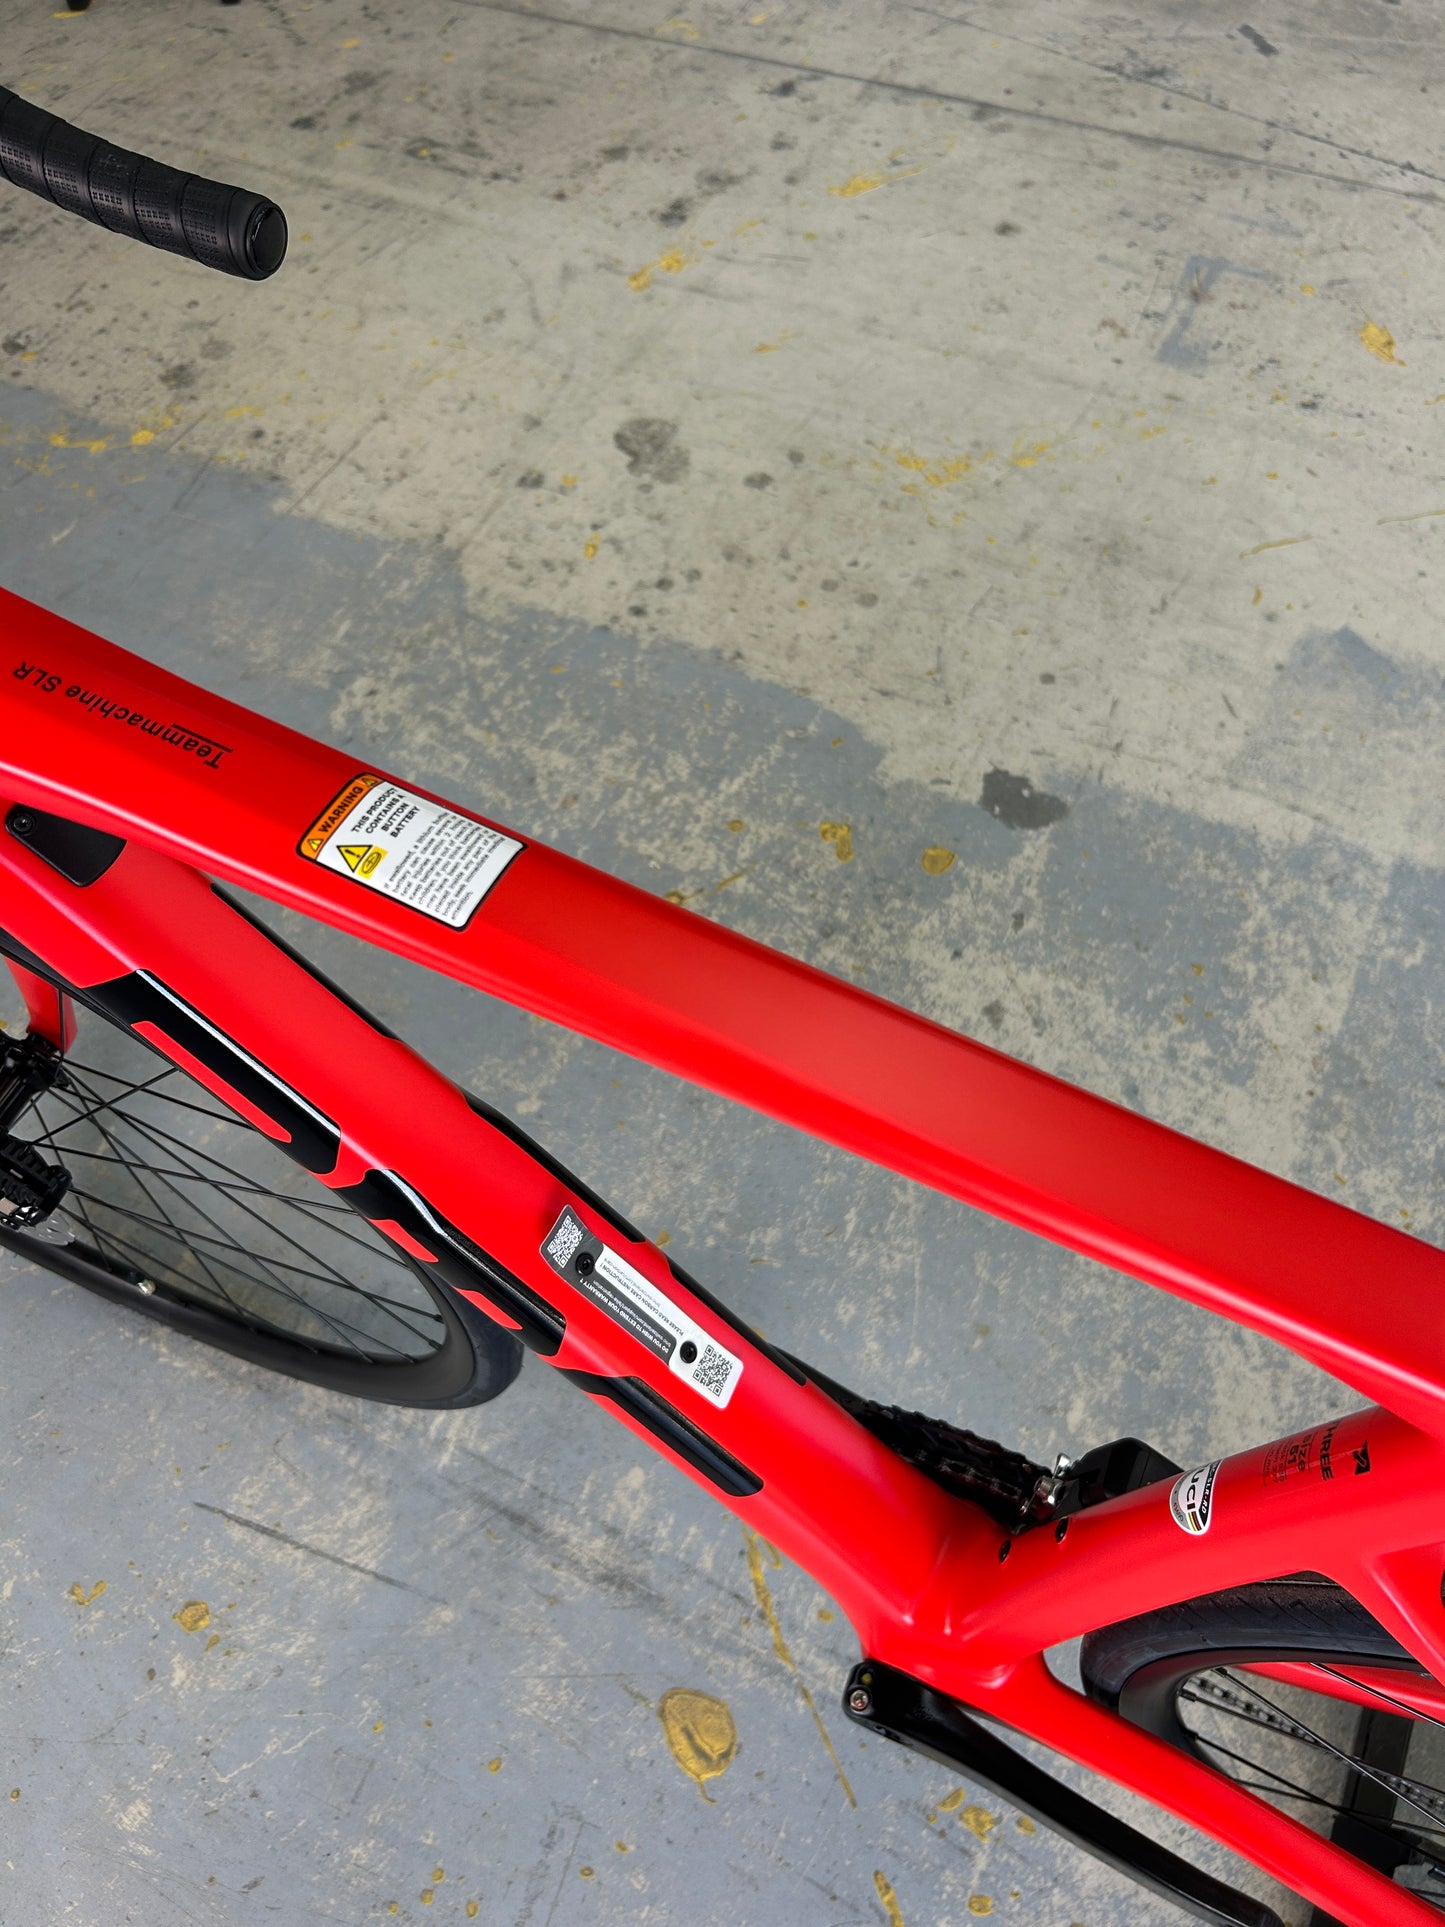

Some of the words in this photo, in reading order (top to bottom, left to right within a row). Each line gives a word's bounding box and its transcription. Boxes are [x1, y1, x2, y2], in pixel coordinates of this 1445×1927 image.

[12, 661, 62, 693] SLR
[66, 684, 223, 769] Teammachine
[317, 785, 364, 833] WARNING
[350, 814, 370, 833] THIS
[365, 787, 398, 815] PRODUCT
[364, 797, 400, 834] CONTAINS
[380, 802, 409, 832] BUTTON
[389, 805, 421, 838] BATTERY
[601, 1264, 631, 1290] INSTRUCTION
[582, 1279, 609, 1303] WARRANTY
[629, 1288, 642, 1300] CARE
[607, 1300, 620, 1313] YOUR
[618, 1309, 636, 1326] EXTEND
[640, 1297, 659, 1314] CARBON
[657, 1311, 669, 1324] READ
[641, 1328, 653, 1340] WISH
[668, 1320, 684, 1336] PLEASE
[652, 1337, 662, 1348] YOU
[1187, 1468, 1205, 1510] UCI
